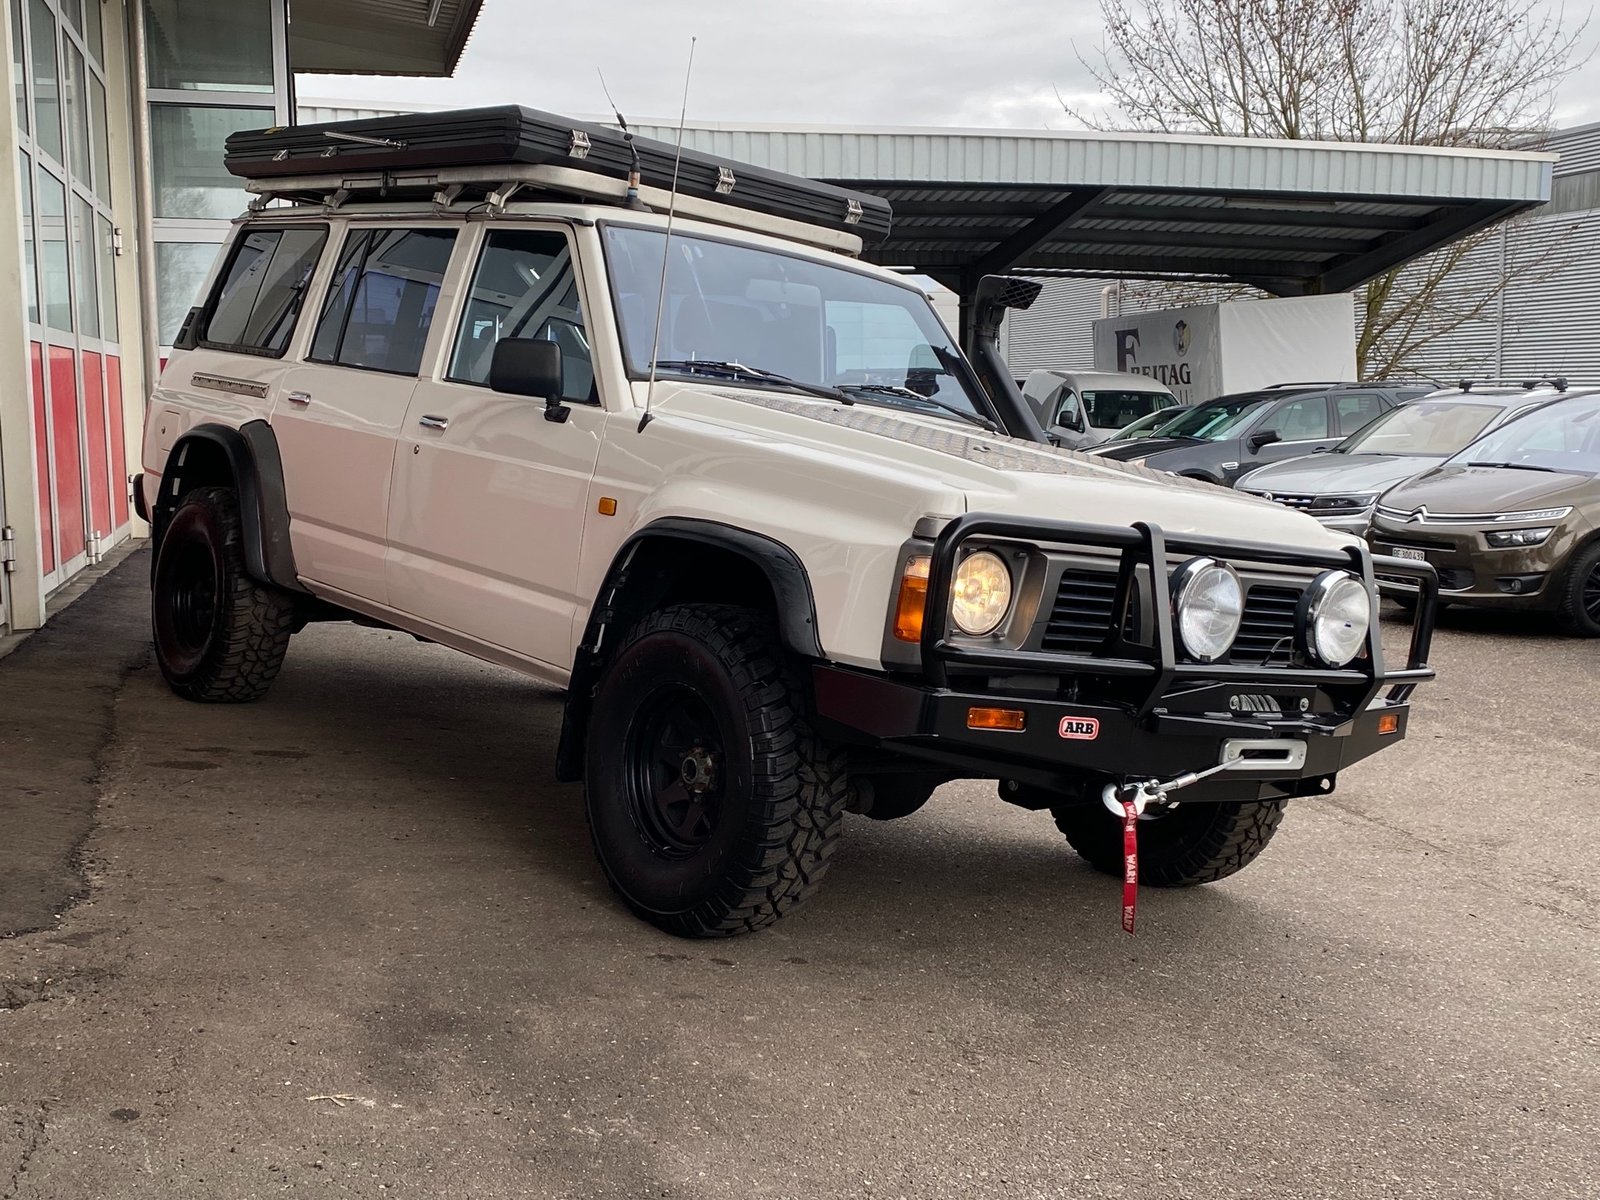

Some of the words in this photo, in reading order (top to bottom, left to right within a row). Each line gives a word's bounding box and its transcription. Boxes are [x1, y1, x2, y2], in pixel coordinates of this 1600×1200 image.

[1064, 721, 1094, 734] ARB
[1125, 804, 1136, 832] WARN
[1126, 854, 1136, 884] WARN
[1124, 905, 1134, 931] WARN
